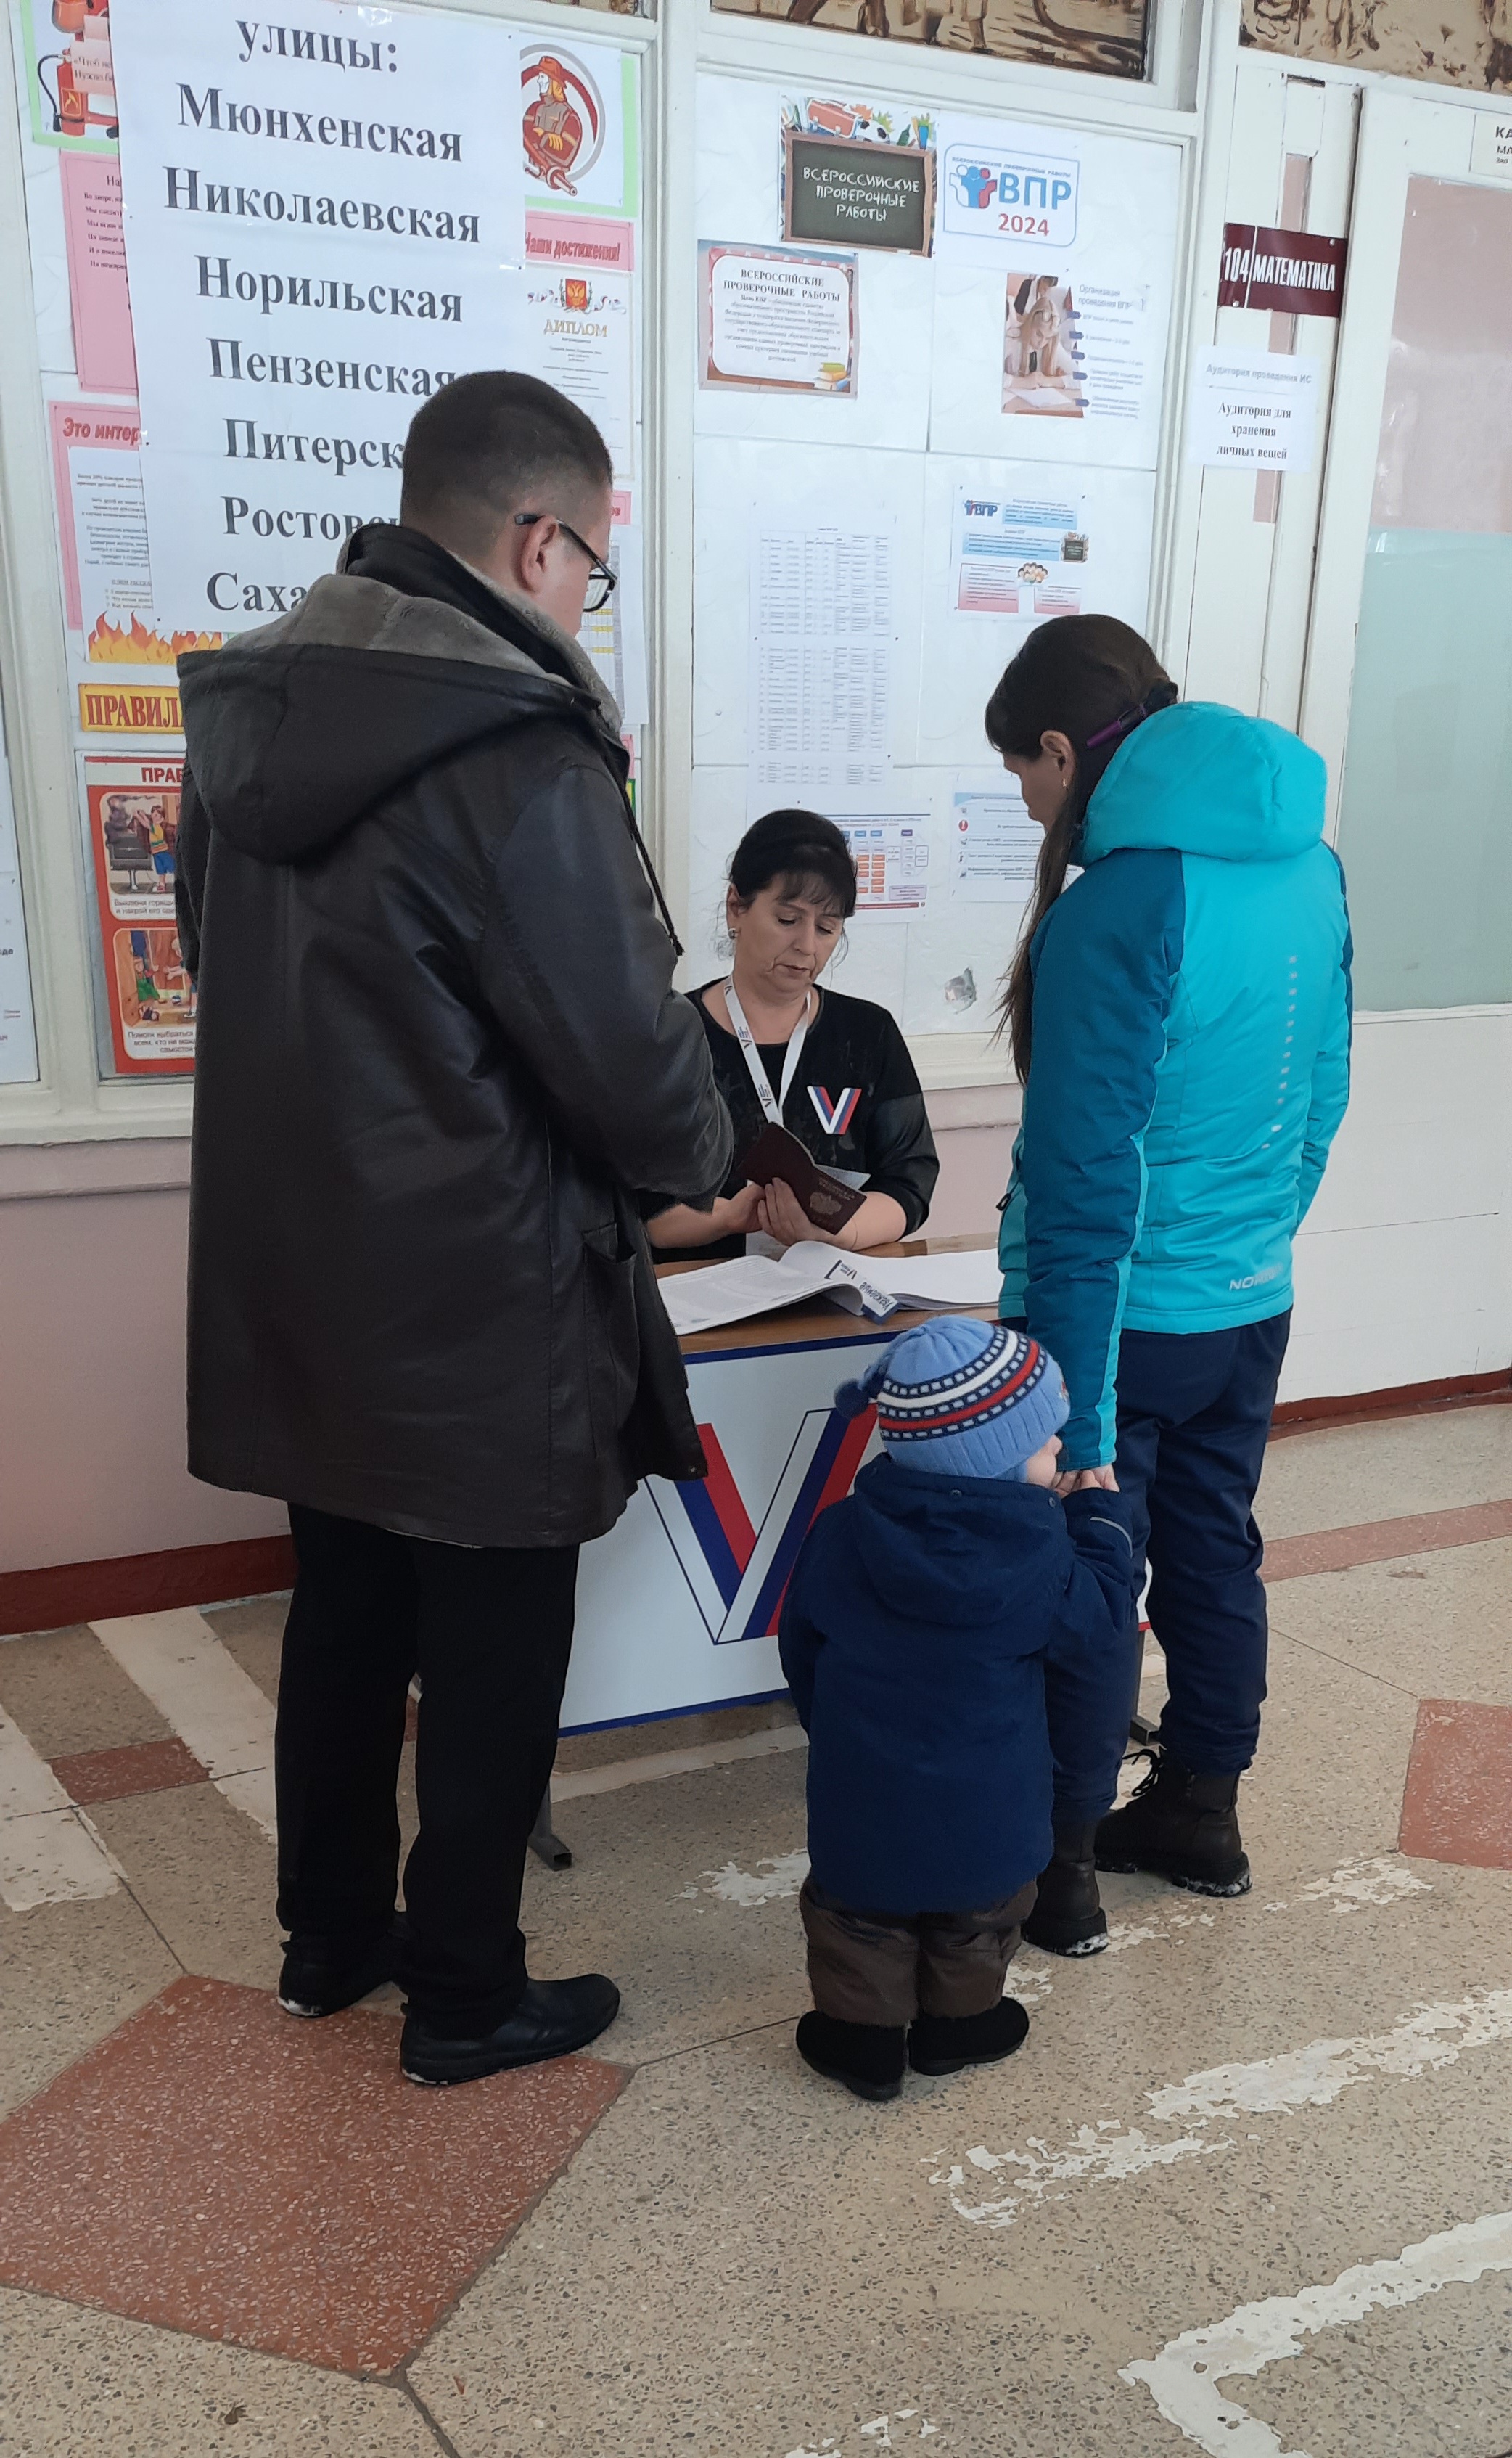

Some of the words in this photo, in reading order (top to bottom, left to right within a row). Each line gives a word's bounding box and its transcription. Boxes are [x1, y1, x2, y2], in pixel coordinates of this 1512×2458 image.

[235, 20, 398, 73] улицы:
[176, 83, 462, 163] Мюнхенская
[803, 167, 920, 193] ВСЕРОССИЙСКИЕ
[998, 172, 1072, 210] ВПР
[163, 165, 480, 243] Николаевская
[816, 185, 907, 208] ПРОВЕРОЧНЫЕ
[836, 203, 887, 221] РАБОТЫ
[998, 213, 1049, 236] 2024
[741, 269, 824, 287] ВСЕРОССИЙСКИЕ
[1224, 247, 1250, 282] 104
[1252, 253, 1336, 291] МАТЕМАТИКА
[194, 255, 463, 322] Норильская
[723, 279, 795, 297] ПРОВЕРОЧНЫЕ
[802, 290, 840, 302] РАБОТЫ
[543, 319, 608, 337] ДИПЛОМ
[206, 337, 456, 397] Пензенская
[1206, 364, 1250, 377] Аудитория
[1252, 370, 1298, 382] проведения
[1299, 374, 1312, 383] ИС
[1218, 402, 1272, 419] Аудитория
[1273, 409, 1291, 419] для
[62, 417, 91, 438] Это
[95, 424, 140, 446] интер
[223, 417, 404, 477] Питерск
[1230, 424, 1277, 438] хранения
[1216, 445, 1255, 457] личных
[1257, 447, 1288, 459] вещей
[220, 496, 399, 541] Ростов
[207, 572, 308, 612] Саха
[85, 694, 184, 729] ПРАВИЛ
